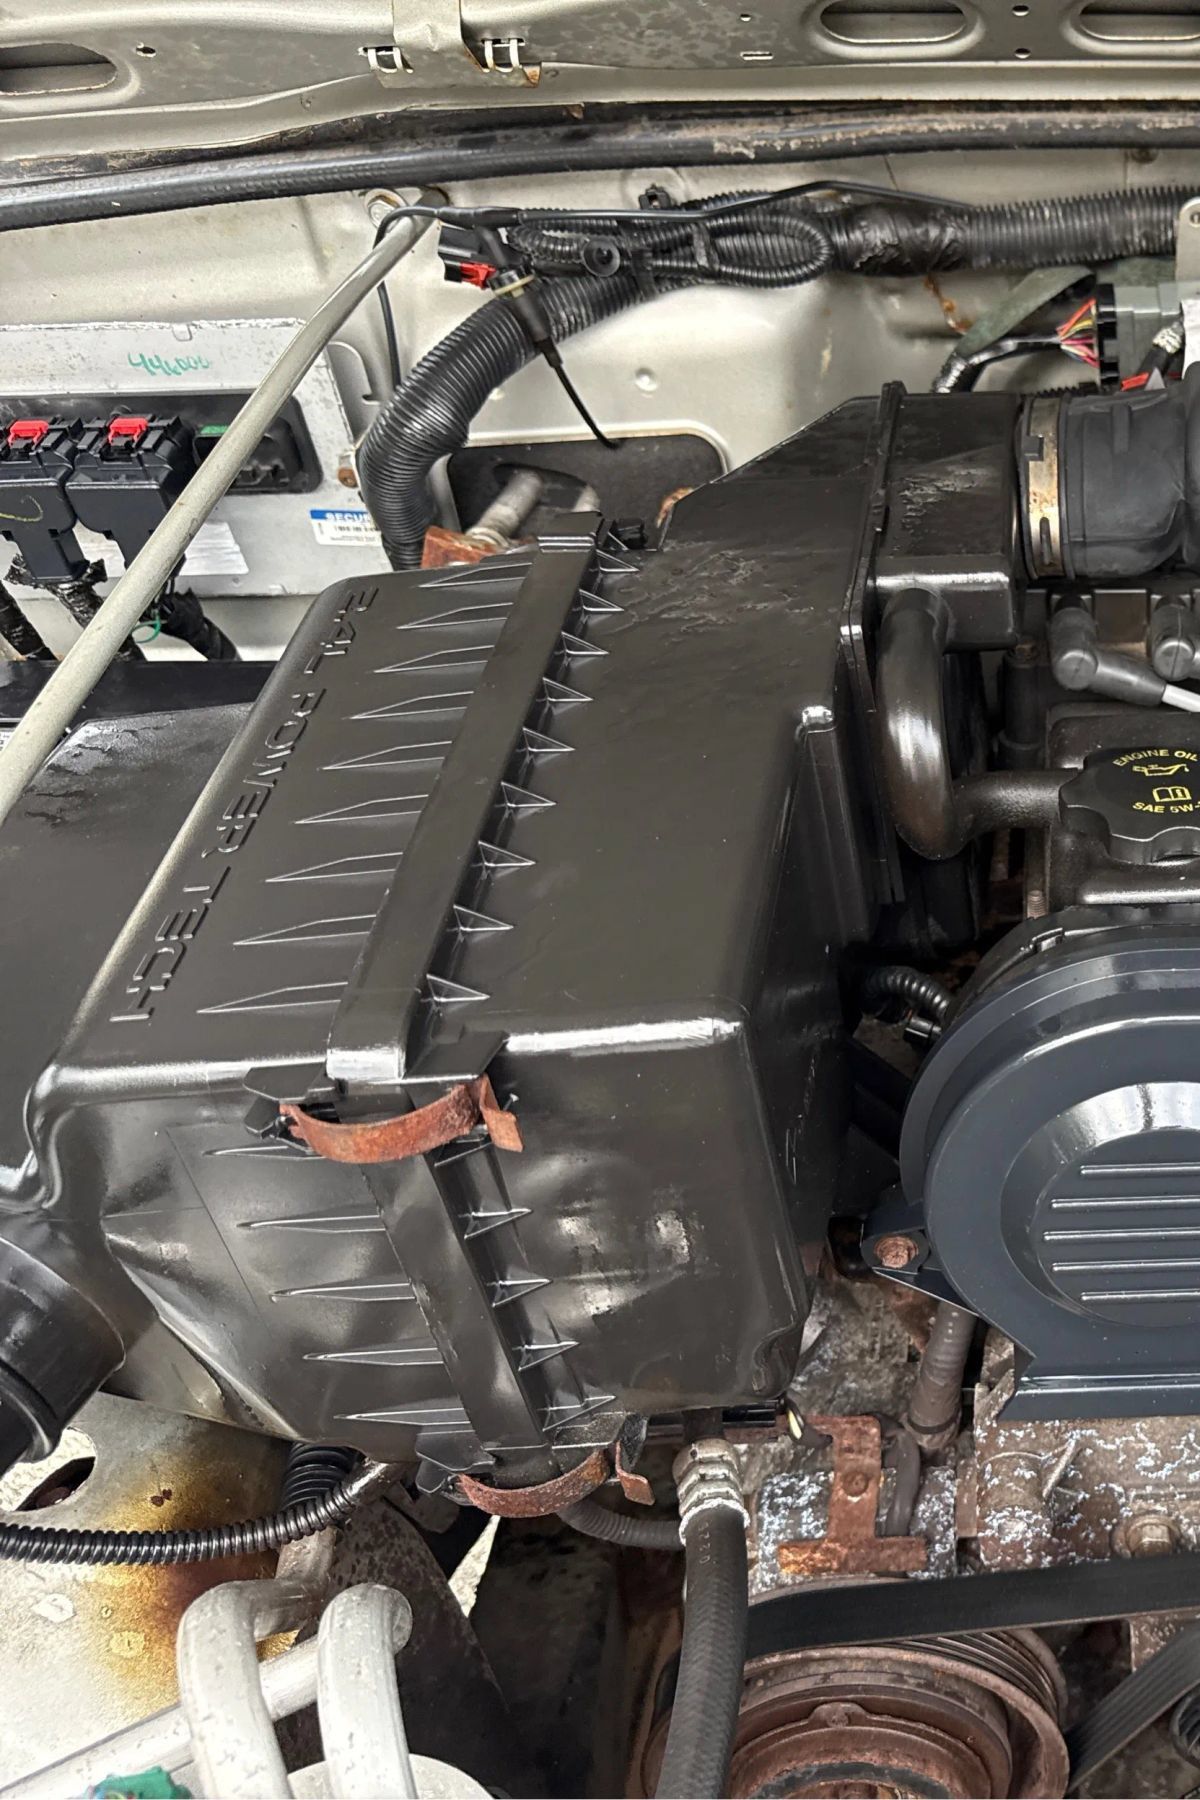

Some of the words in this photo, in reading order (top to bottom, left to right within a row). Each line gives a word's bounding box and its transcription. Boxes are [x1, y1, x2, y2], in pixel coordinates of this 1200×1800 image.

[200, 687, 327, 859] POWER
[1112, 749, 1169, 766] ENGINE
[1174, 750, 1198, 762] OIL
[1132, 802, 1165, 813] SAE
[109, 866, 232, 1022] TECH
